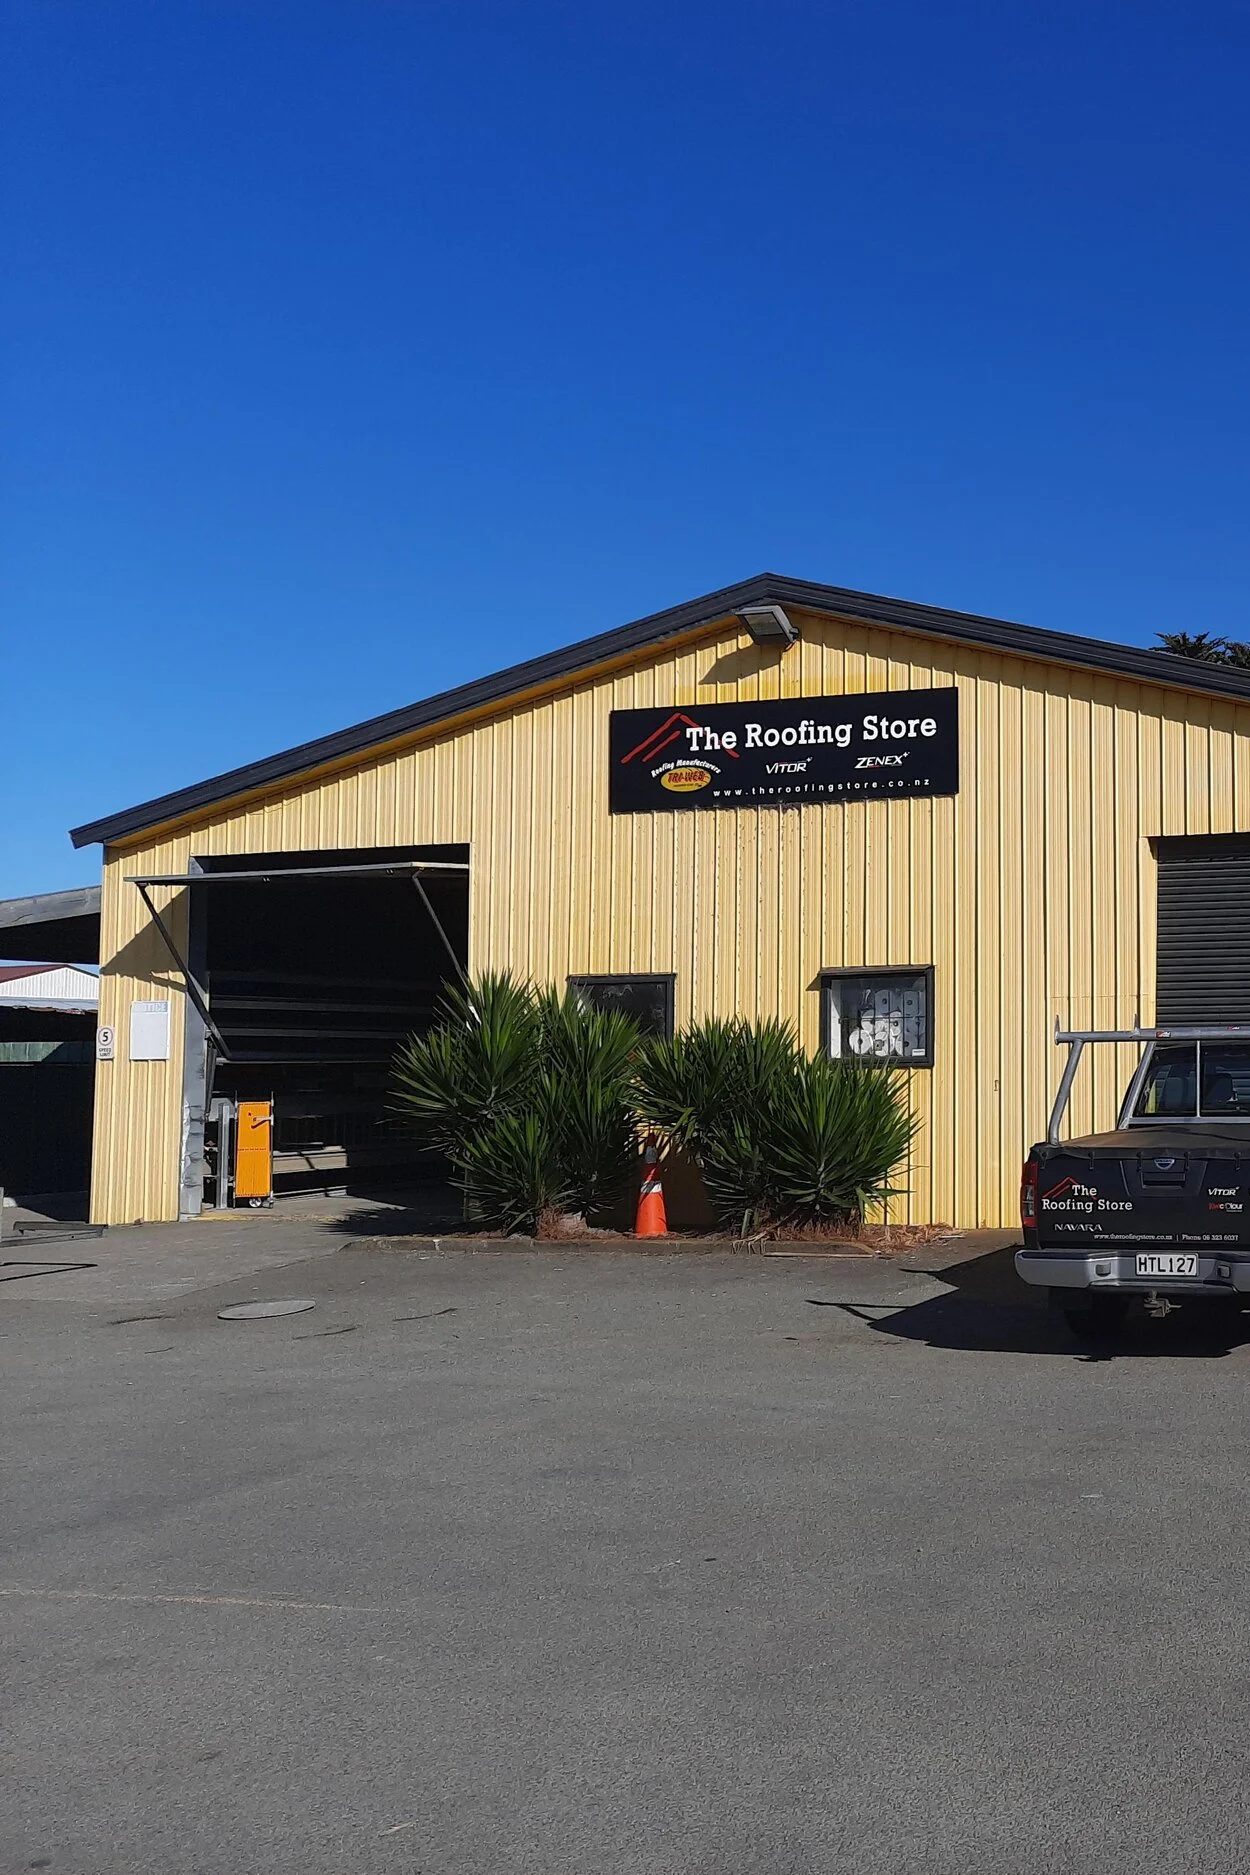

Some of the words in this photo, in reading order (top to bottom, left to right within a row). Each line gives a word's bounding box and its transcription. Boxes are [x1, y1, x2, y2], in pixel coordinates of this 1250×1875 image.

[686, 727, 737, 751] The
[745, 720, 852, 748] Roofing
[863, 715, 937, 740] Store
[766, 762, 807, 774] VITOR
[854, 755, 903, 769] ZENEX
[651, 762, 675, 778] Roofing
[713, 778, 930, 797] www.theroofingstore.co.nz
[102, 1031, 109, 1042] 5
[1072, 1184, 1097, 1196] The
[1208, 1187, 1236, 1196] VITOR
[1041, 1199, 1094, 1213] Roofing
[1097, 1199, 1133, 1210] Store
[1054, 1223, 1103, 1232] NAVARA
[1138, 1257, 1195, 1273] HTL127
